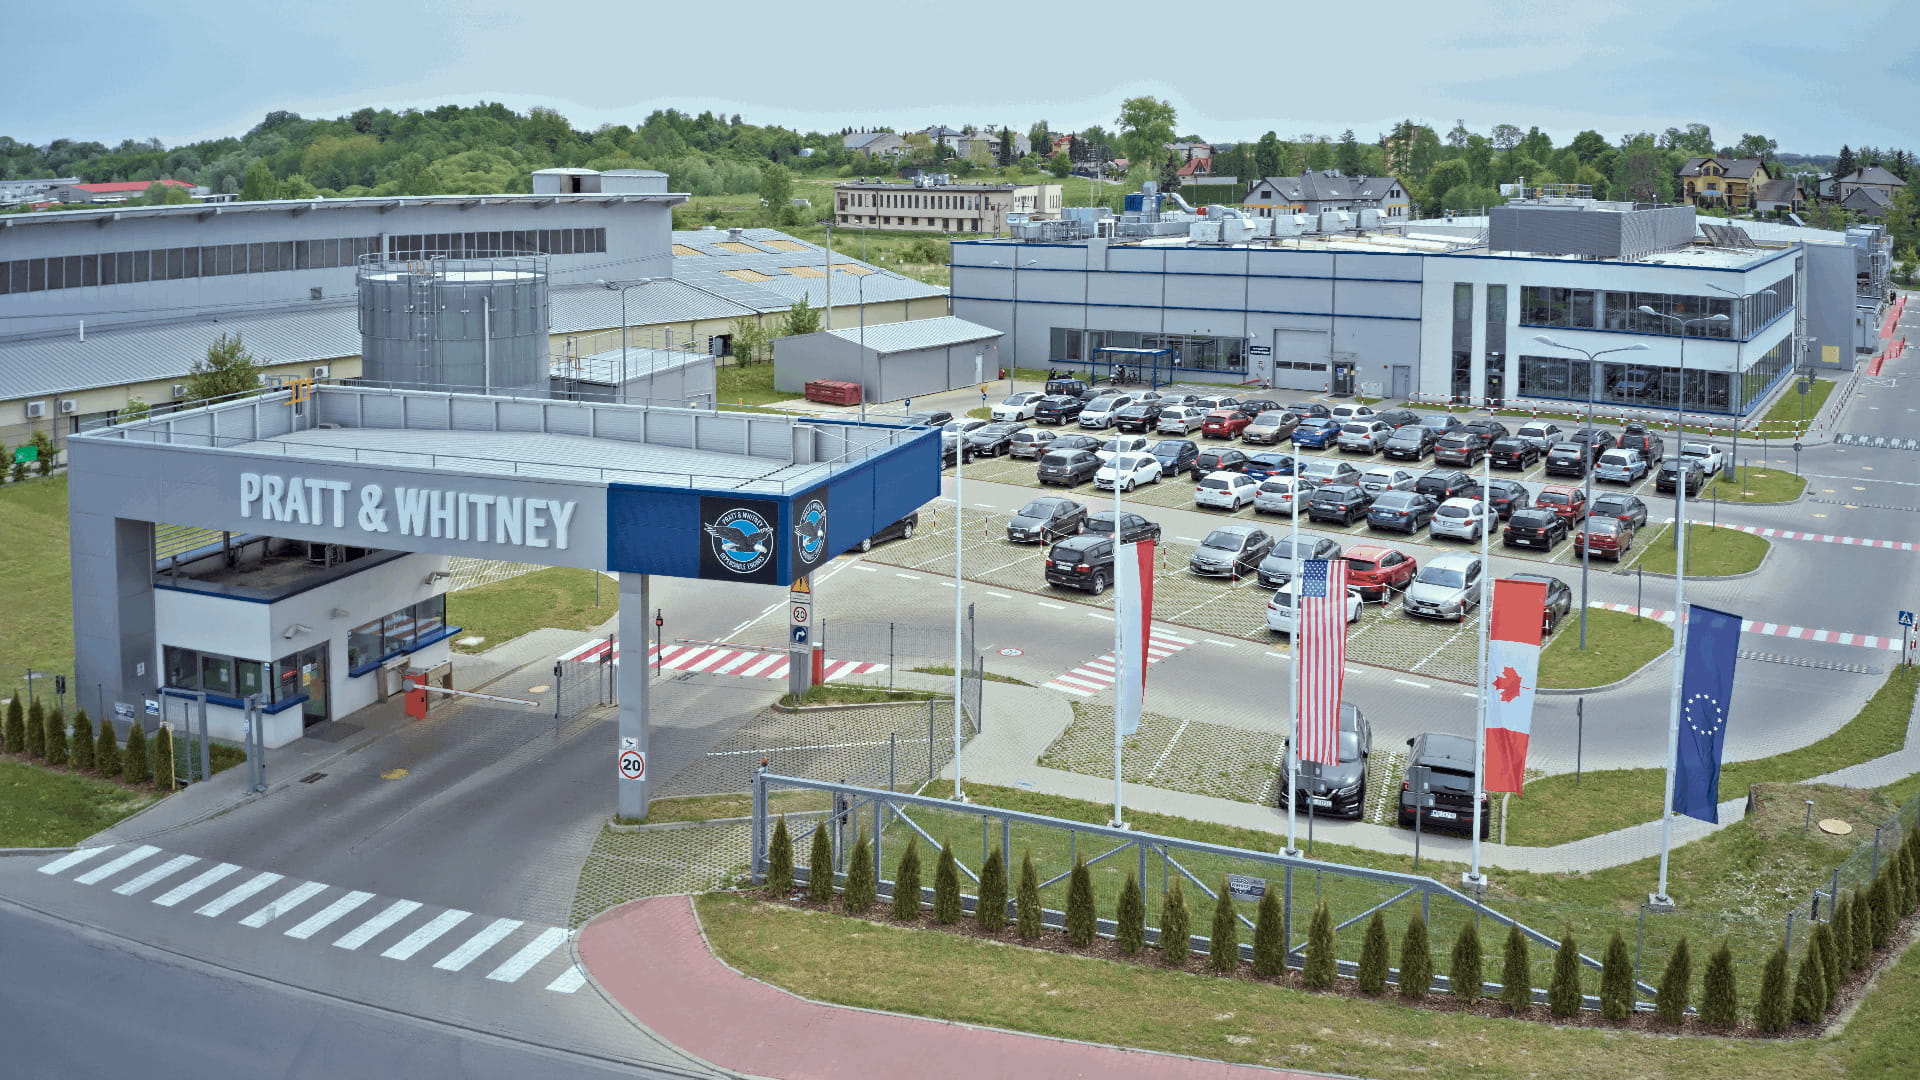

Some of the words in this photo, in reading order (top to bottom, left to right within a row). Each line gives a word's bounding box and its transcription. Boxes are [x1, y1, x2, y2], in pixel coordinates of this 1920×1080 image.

[240, 472, 351, 528] PRATT
[358, 484, 389, 534] &
[395, 487, 577, 550] WHITNEY
[795, 610, 805, 619] 20
[622, 758, 641, 772] 20
